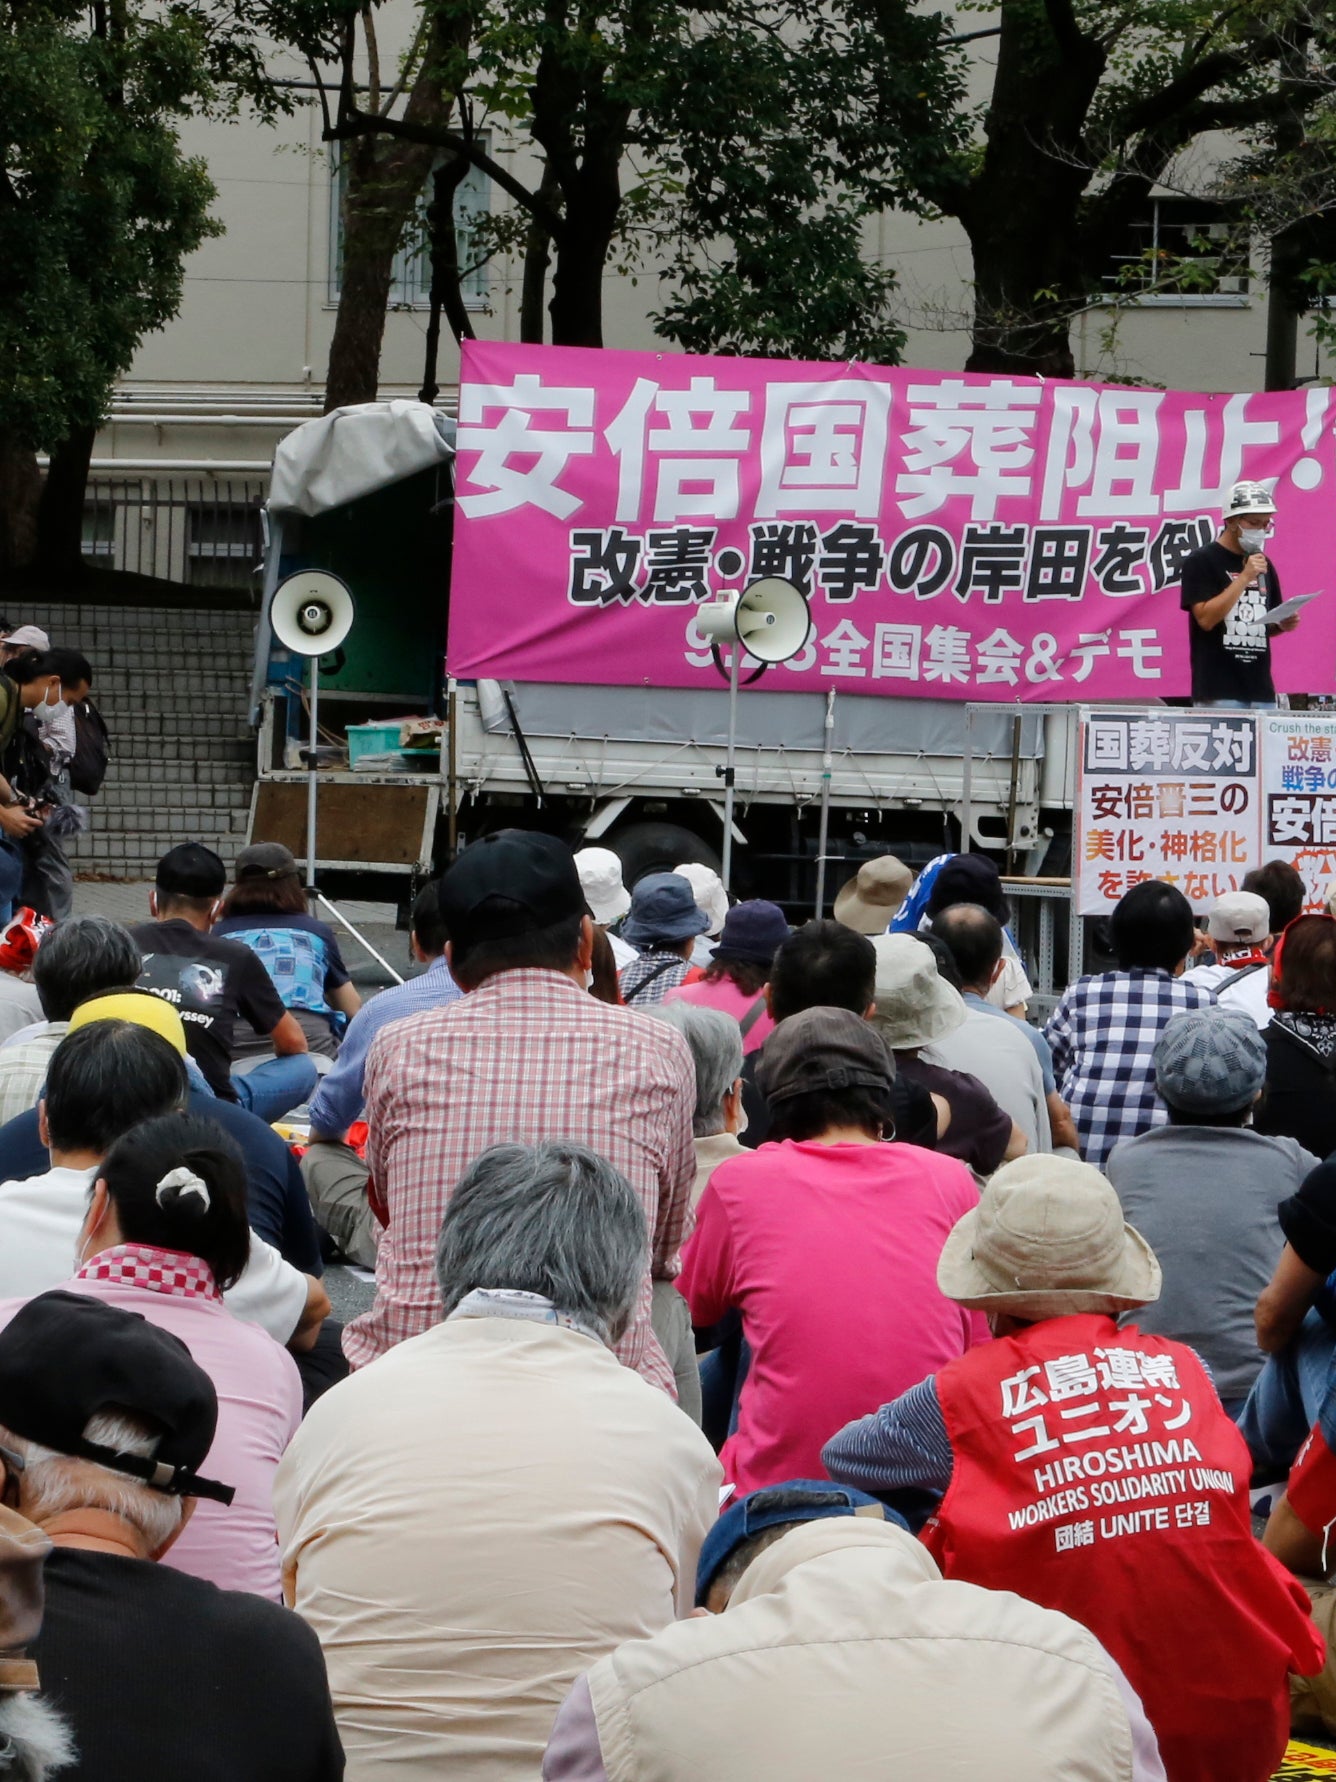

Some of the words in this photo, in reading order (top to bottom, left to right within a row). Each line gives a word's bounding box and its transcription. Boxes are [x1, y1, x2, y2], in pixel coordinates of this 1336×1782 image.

[456, 374, 1329, 522] 安倍国葬阻止!
[568, 518, 1274, 606] 改憲・戦争の岸田を倒
[1088, 721, 1253, 772] 国葬反対
[1269, 722, 1301, 733] Crush
[1304, 722, 1322, 734] the
[1091, 783, 1249, 820] 安倍晋三の
[1085, 829, 1248, 863] 美化・神格化
[1001, 1347, 1181, 1418] 広島連帯
[1011, 1393, 1192, 1462] ユニオン
[1034, 1438, 1202, 1493] HIROSHIMA
[1008, 1487, 1090, 1530] WORKERS
[1090, 1470, 1187, 1508] SOLIDARITY
[1190, 1467, 1235, 1495] UNION
[1055, 1520, 1095, 1552] 団結
[1100, 1507, 1169, 1539] UNITE
[1175, 1501, 1211, 1528] 단결
